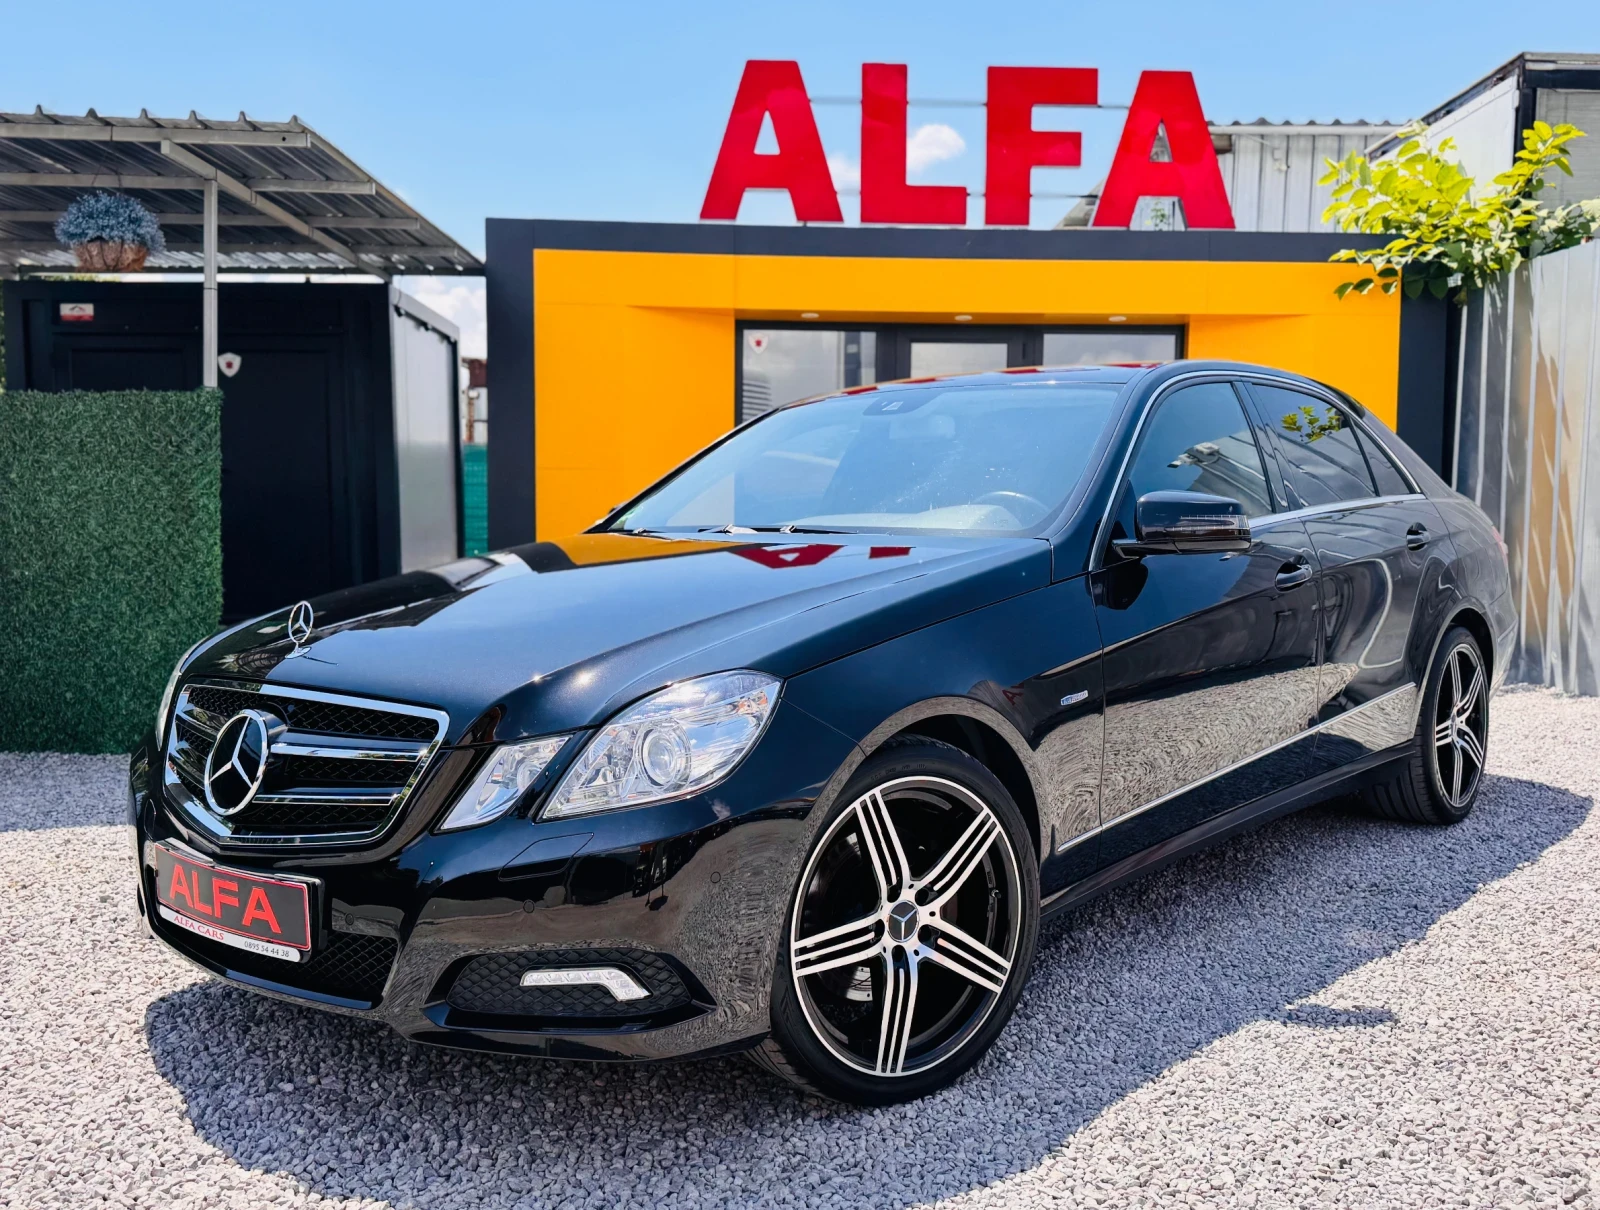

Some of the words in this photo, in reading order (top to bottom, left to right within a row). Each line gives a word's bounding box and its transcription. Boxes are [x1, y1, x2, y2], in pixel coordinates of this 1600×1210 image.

[700, 59, 1236, 229] ALFA
[169, 863, 282, 934] ALFA
[173, 915, 195, 930] ALFA
[197, 925, 224, 941] CARS
[244, 940, 260, 951] 0895
[260, 944, 269, 953] 54
[270, 946, 280, 956] 44
[281, 949, 290, 958] 38
